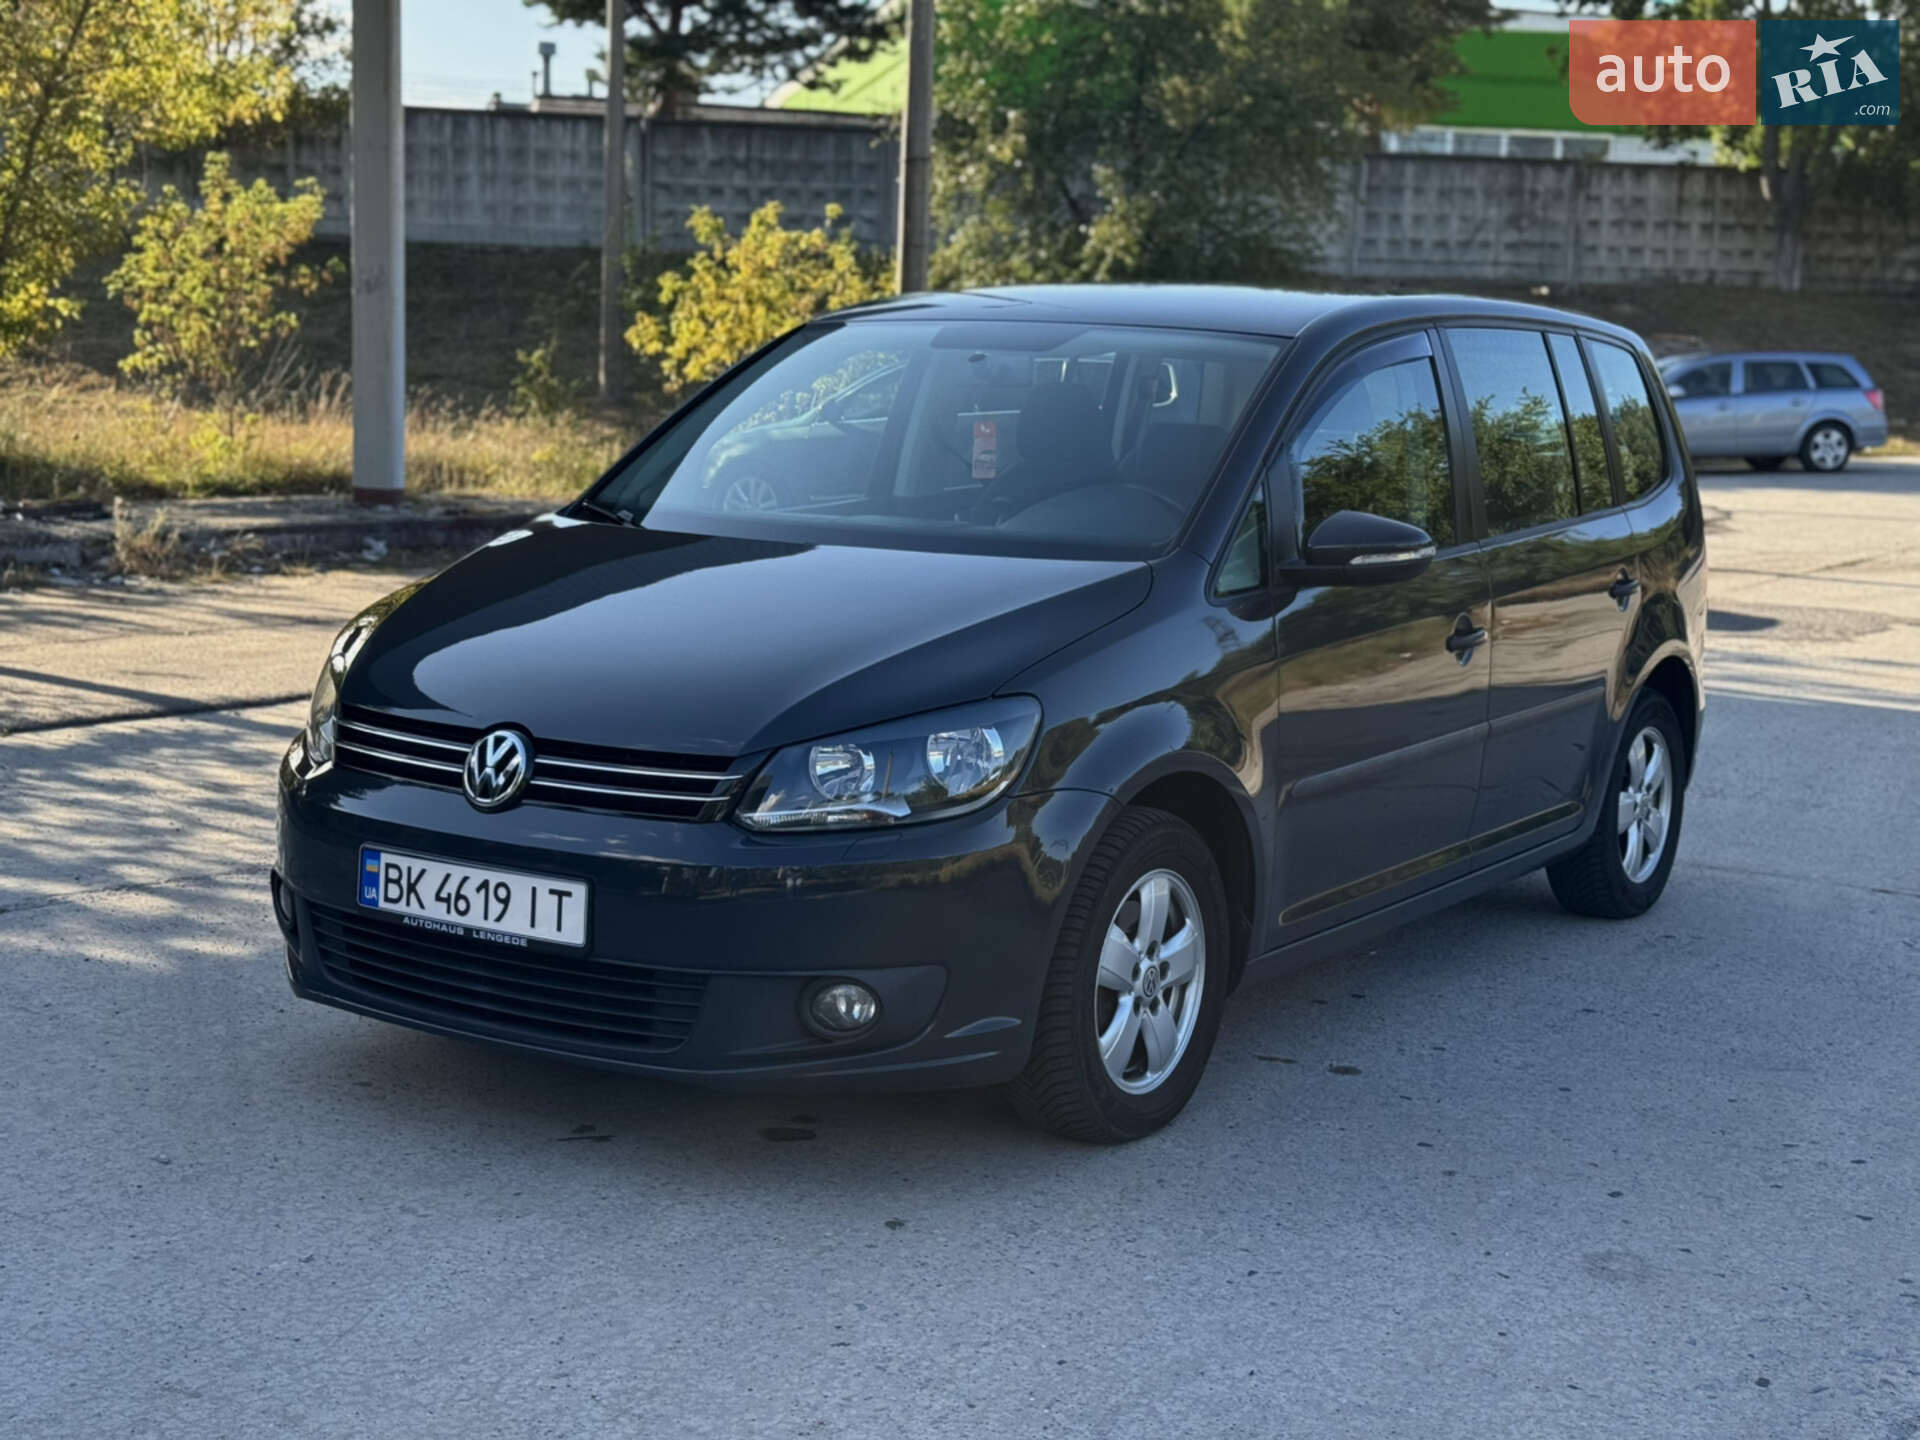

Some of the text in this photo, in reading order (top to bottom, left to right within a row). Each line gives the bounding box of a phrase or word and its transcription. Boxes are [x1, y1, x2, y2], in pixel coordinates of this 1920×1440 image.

[364, 885, 378, 900] UA
[383, 862, 573, 932] BK 4619 IT
[402, 916, 528, 947] AUTOHAUS LENGEDE
